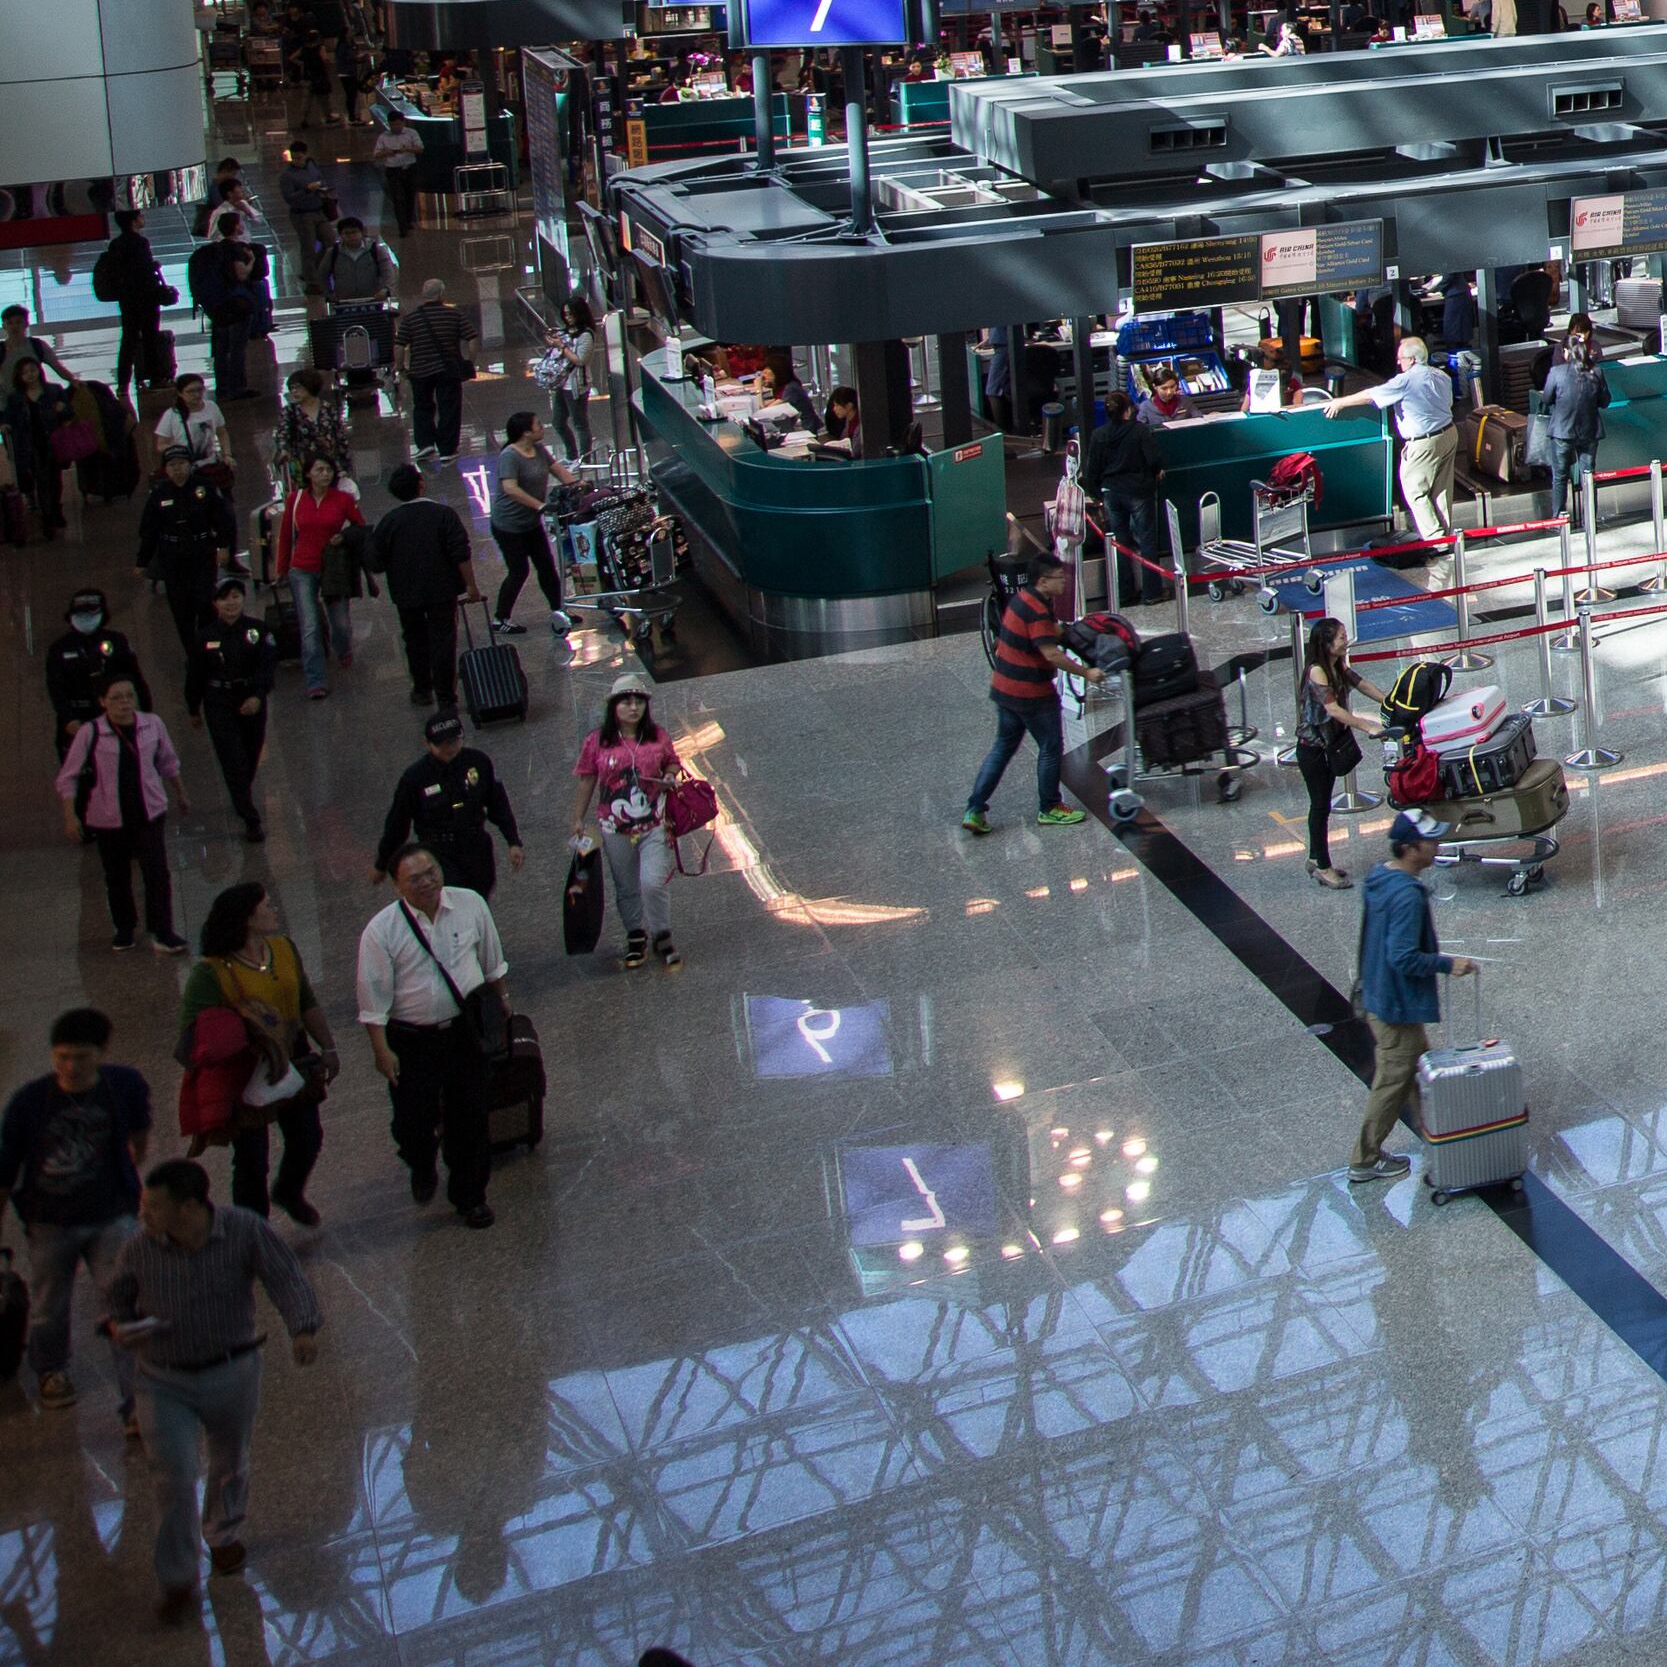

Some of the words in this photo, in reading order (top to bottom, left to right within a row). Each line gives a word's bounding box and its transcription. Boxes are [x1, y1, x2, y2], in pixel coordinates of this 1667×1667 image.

[1602, 208, 1622, 217] CHINA
[1279, 246, 1292, 254] AIR
[1293, 243, 1315, 252] CHINA
